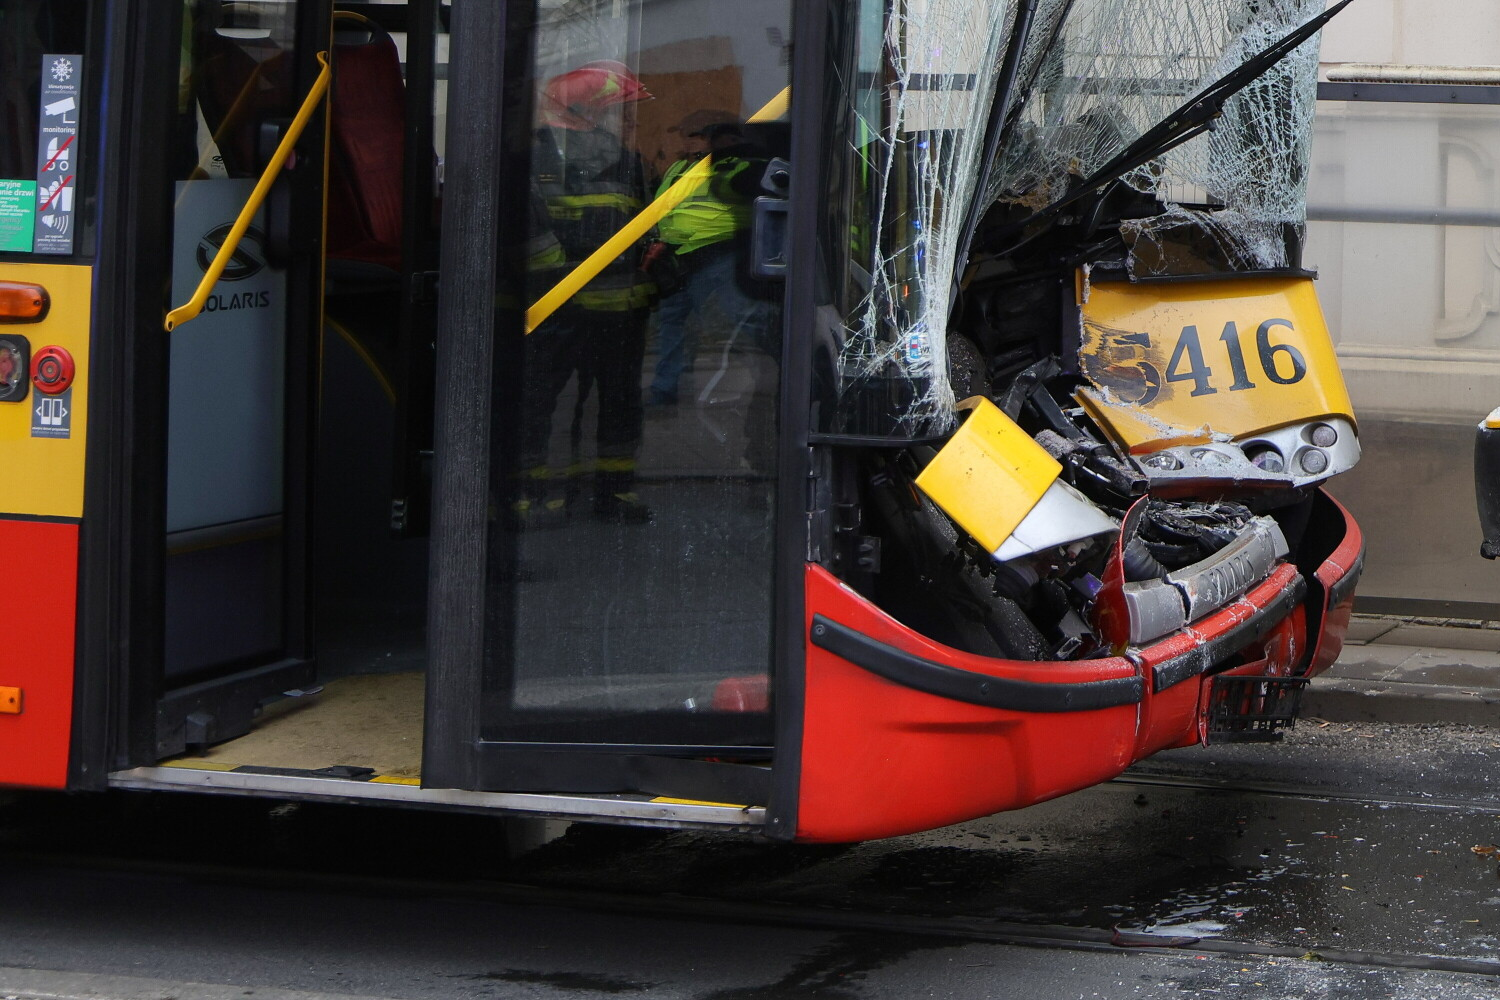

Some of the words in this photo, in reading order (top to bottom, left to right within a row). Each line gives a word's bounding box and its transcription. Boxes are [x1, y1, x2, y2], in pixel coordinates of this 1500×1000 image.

[43, 126, 75, 135] monitoring
[200, 290, 269, 313] OLARIS
[1090, 318, 1307, 406] 5416
